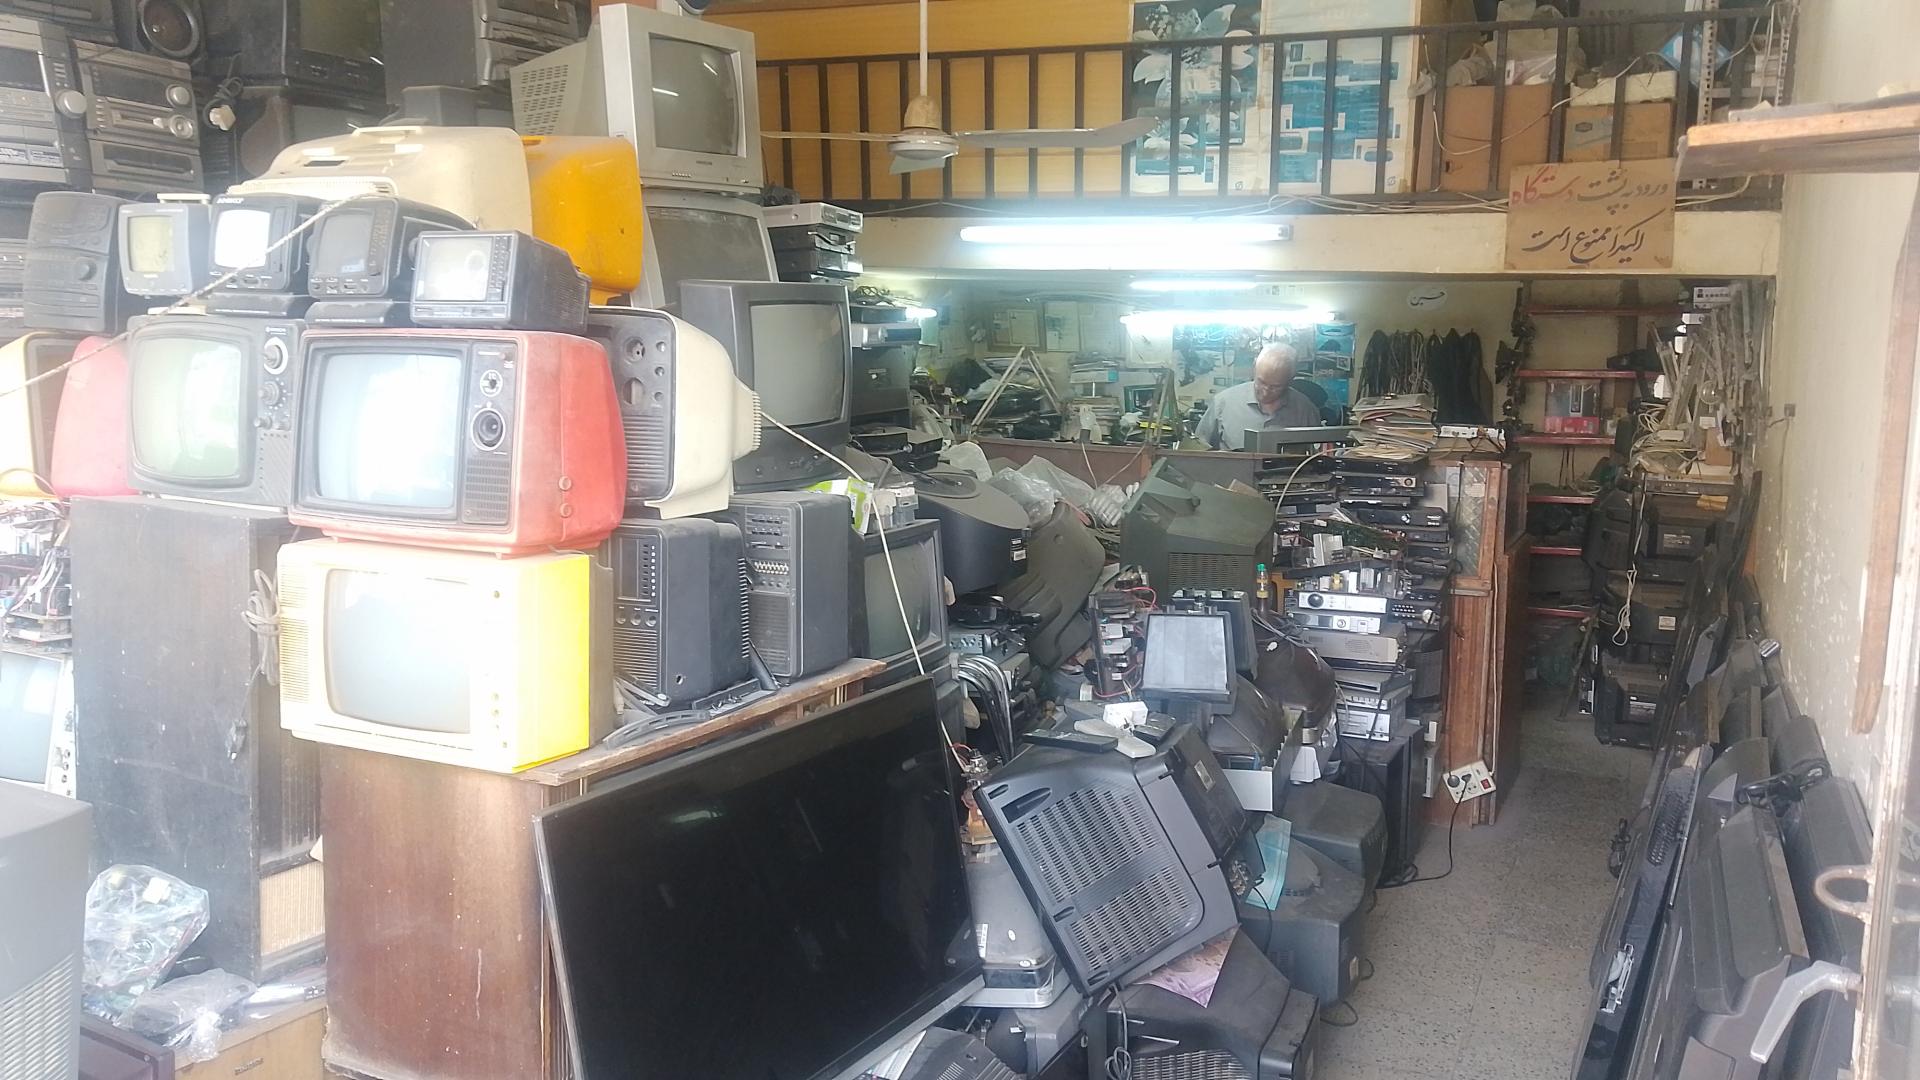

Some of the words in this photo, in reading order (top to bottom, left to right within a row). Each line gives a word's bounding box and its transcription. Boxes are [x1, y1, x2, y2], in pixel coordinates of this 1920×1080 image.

[1511, 165, 1582, 204] دستگاه
[1577, 170, 1628, 216] پشت
[1634, 183, 1669, 198] ورود
[1521, 226, 1572, 252] است
[1570, 226, 1612, 264] ممنوع
[1409, 290, 1446, 307] حسین
